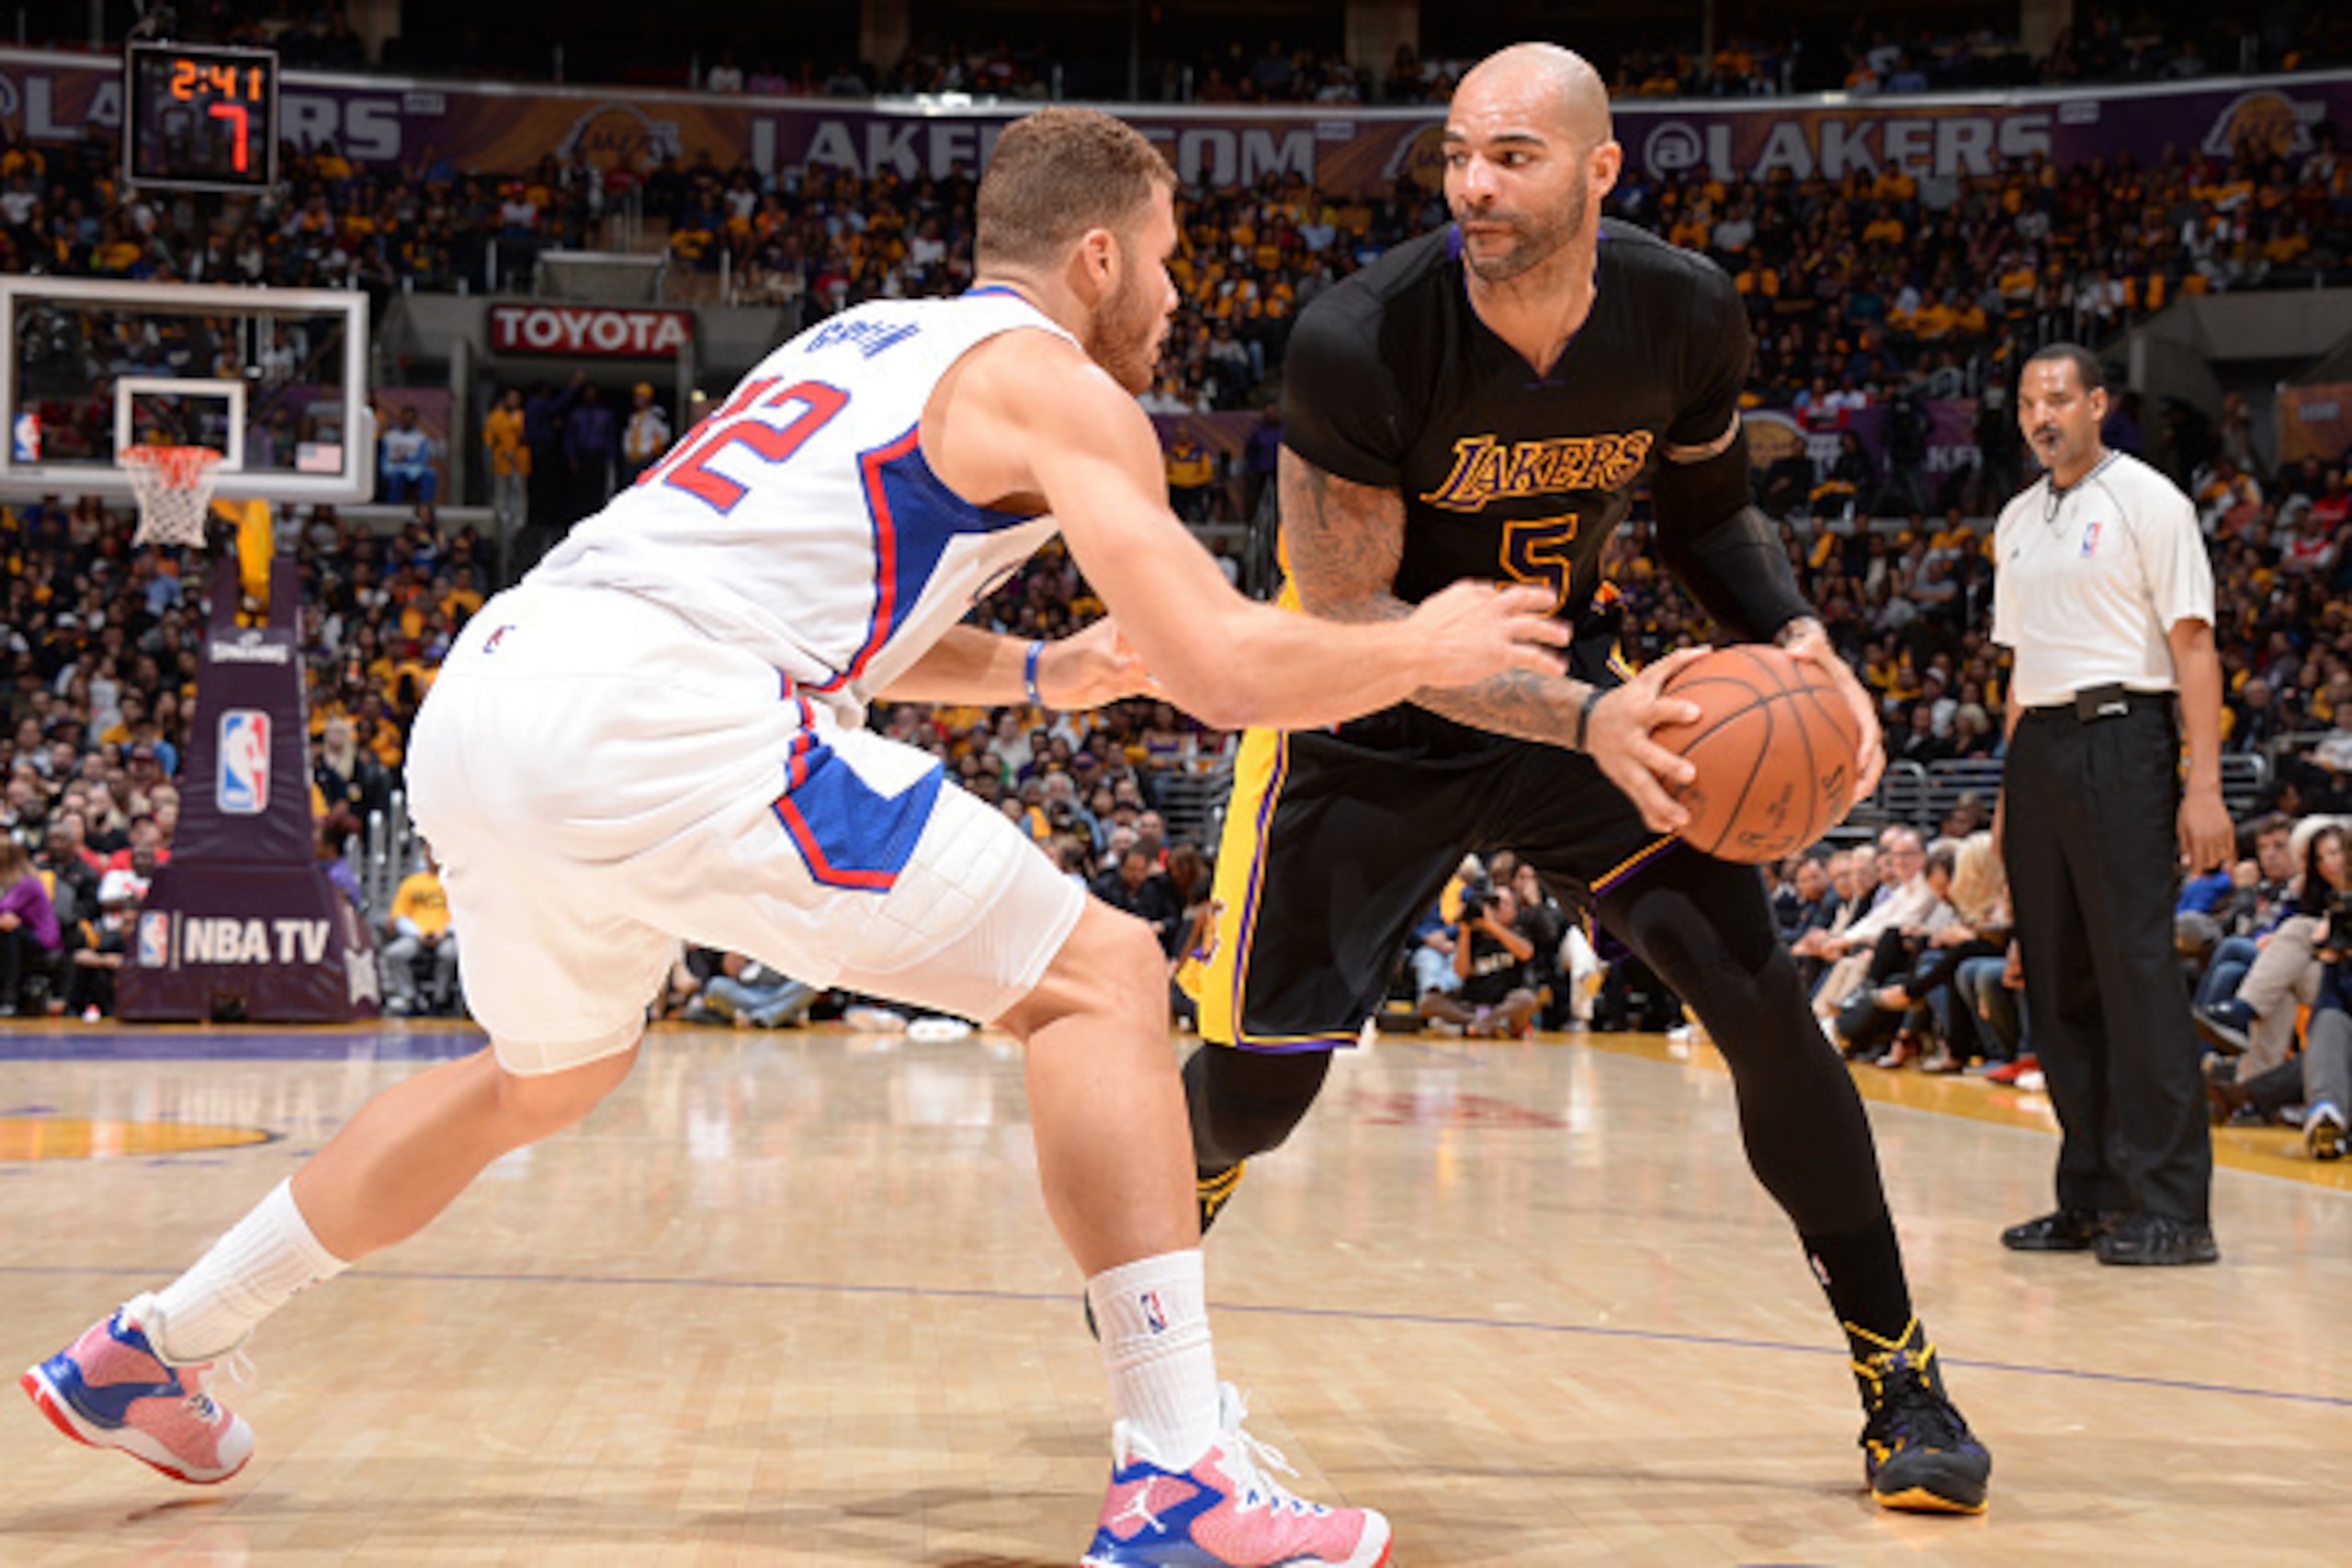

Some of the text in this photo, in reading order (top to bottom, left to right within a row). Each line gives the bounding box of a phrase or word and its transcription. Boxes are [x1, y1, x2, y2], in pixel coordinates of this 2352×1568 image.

[172, 59, 261, 101] 2:41
[209, 103, 248, 172] 7
[1644, 114, 2052, 182] @LAKERS
[494, 309, 685, 350] TOYOTA
[1419, 430, 1653, 512] LAKERS
[1498, 513, 1578, 617] 5
[185, 921, 330, 963] NBA TV
